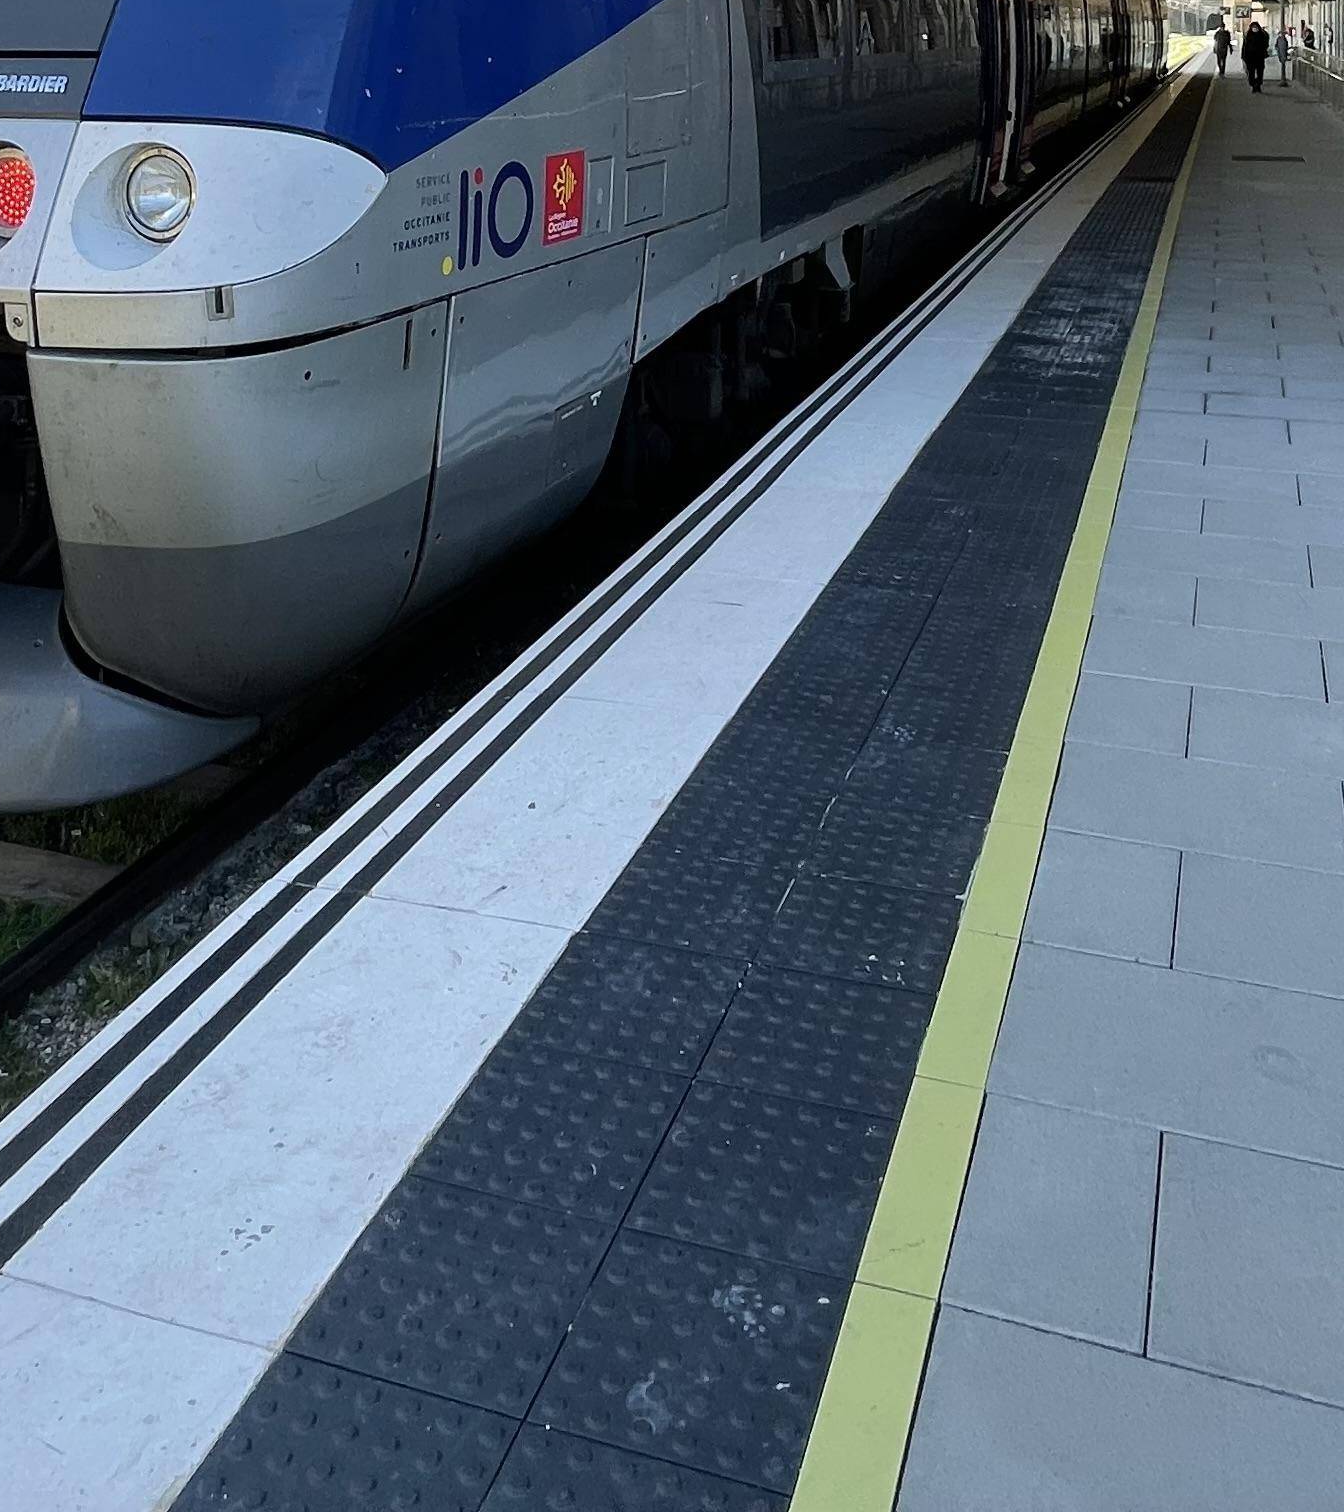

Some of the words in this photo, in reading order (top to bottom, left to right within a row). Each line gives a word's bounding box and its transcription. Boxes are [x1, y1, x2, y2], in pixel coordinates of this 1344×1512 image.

[415, 172, 451, 188] SERVICE
[420, 192, 451, 207] PUBLIC
[403, 211, 451, 231] OCCITANIE
[392, 231, 450, 253] TRANSPORTS
